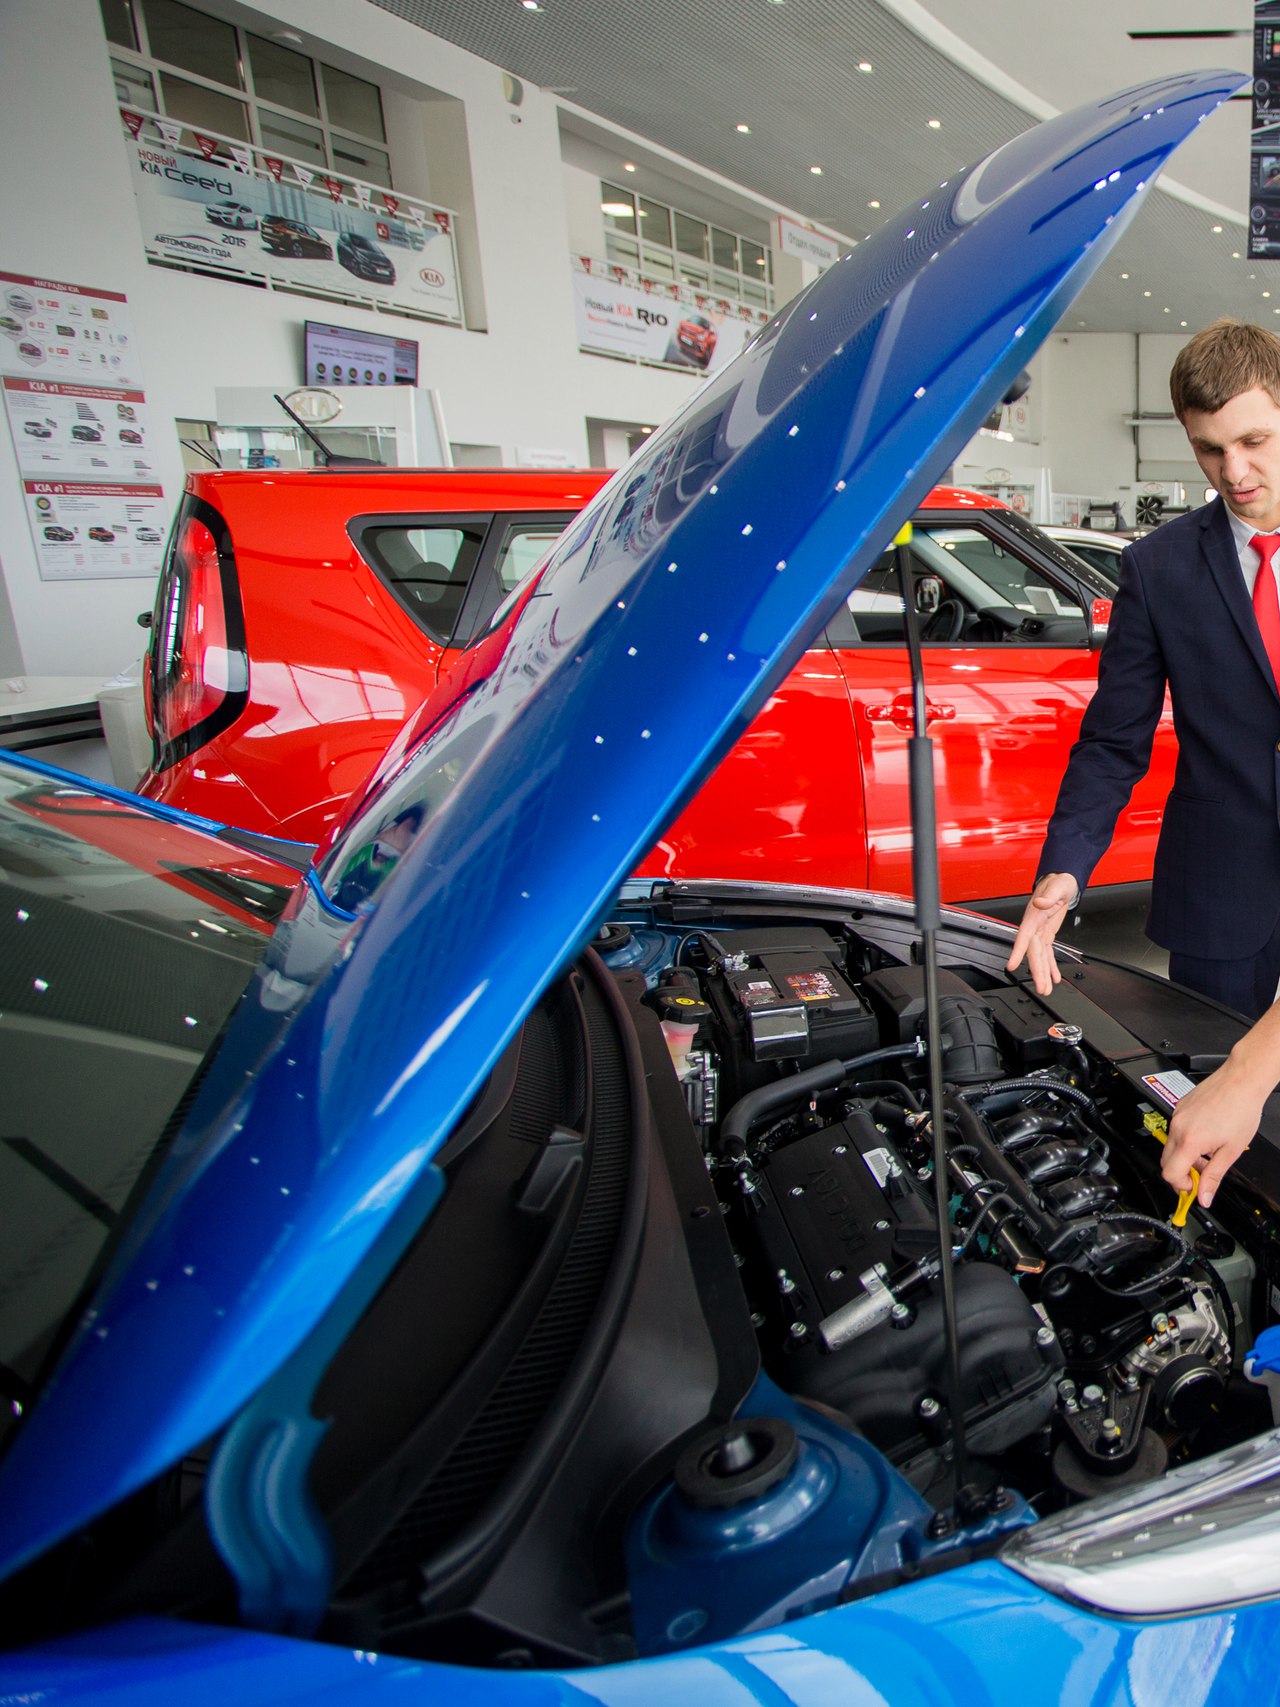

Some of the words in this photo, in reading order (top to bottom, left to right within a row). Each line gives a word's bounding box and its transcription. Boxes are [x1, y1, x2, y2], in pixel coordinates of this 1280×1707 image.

[137, 148, 177, 168] НОВЫЙ
[140, 160, 163, 177] KIA
[154, 234, 210, 254] АВТОМОБИЛЬ
[210, 247, 233, 259] ГОДА
[221, 233, 247, 249] 2015
[28, 380, 48, 392] KIA
[292, 396, 334, 417] KIA
[33, 482, 53, 494] KIA
